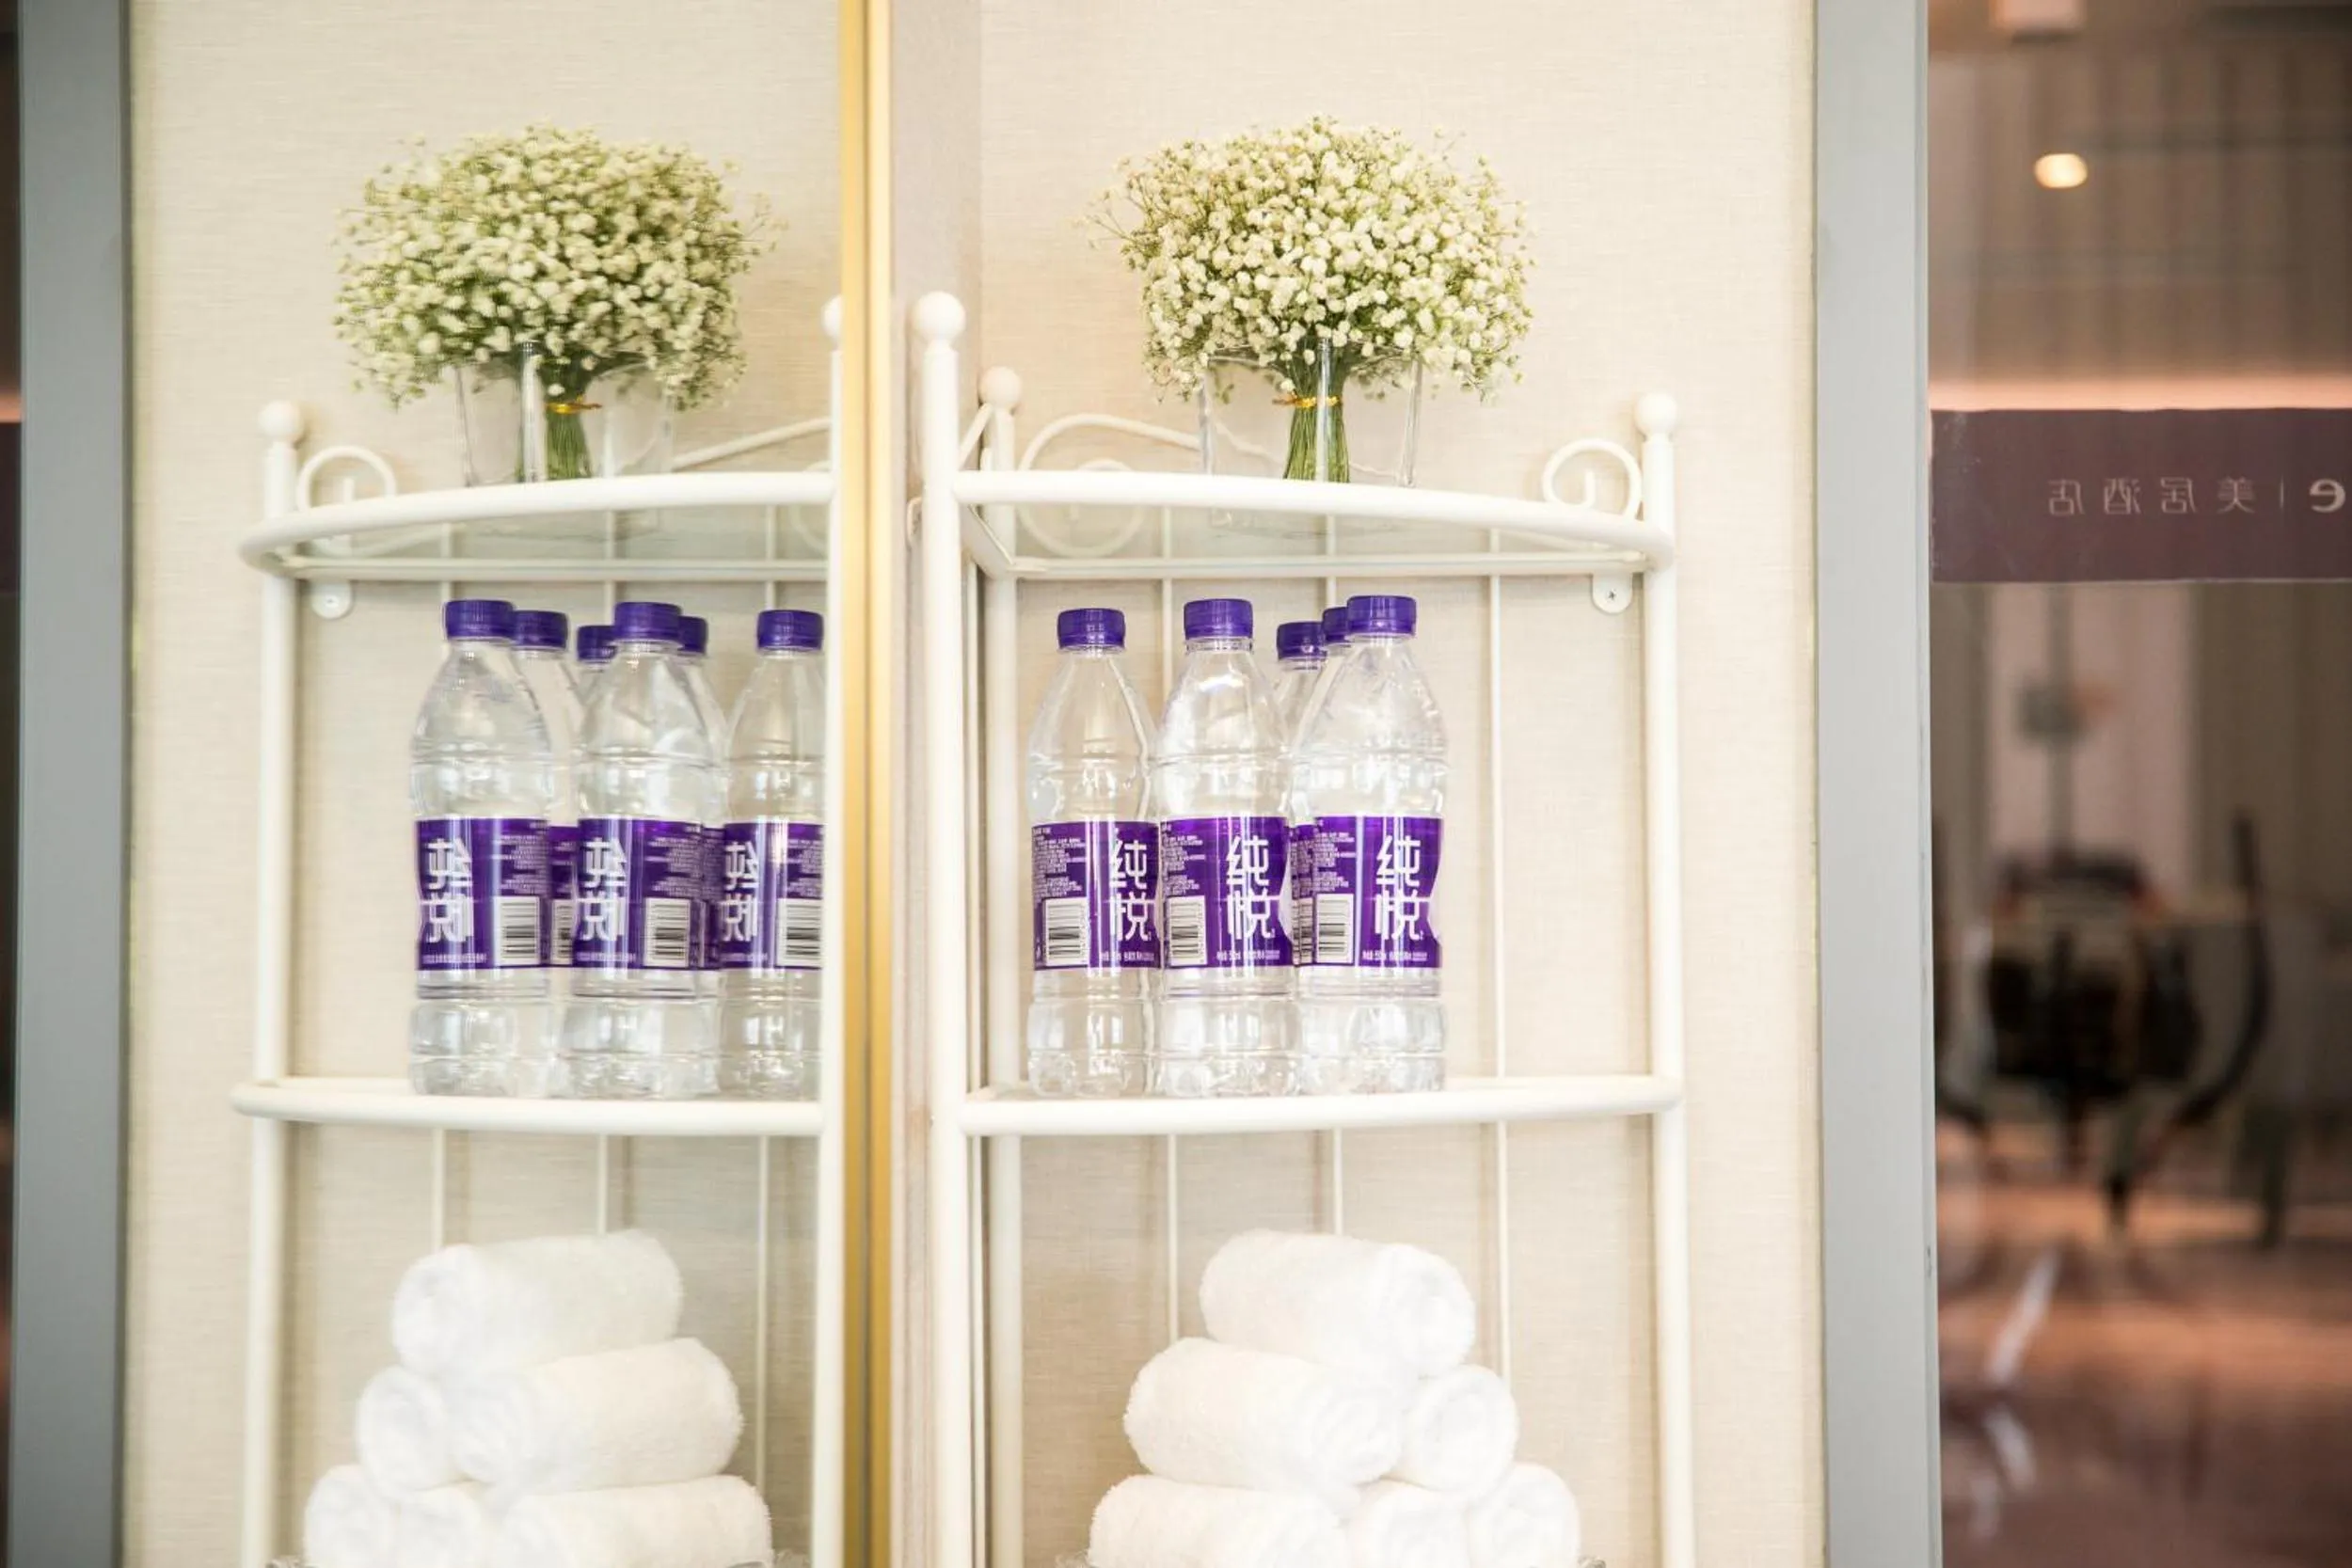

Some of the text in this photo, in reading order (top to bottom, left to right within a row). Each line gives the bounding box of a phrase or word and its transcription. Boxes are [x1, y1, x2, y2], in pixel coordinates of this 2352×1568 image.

[1110, 839, 1152, 942] 纯悦
[1226, 834, 1272, 941] 纯悦
[1375, 834, 1422, 941] 纯悦
